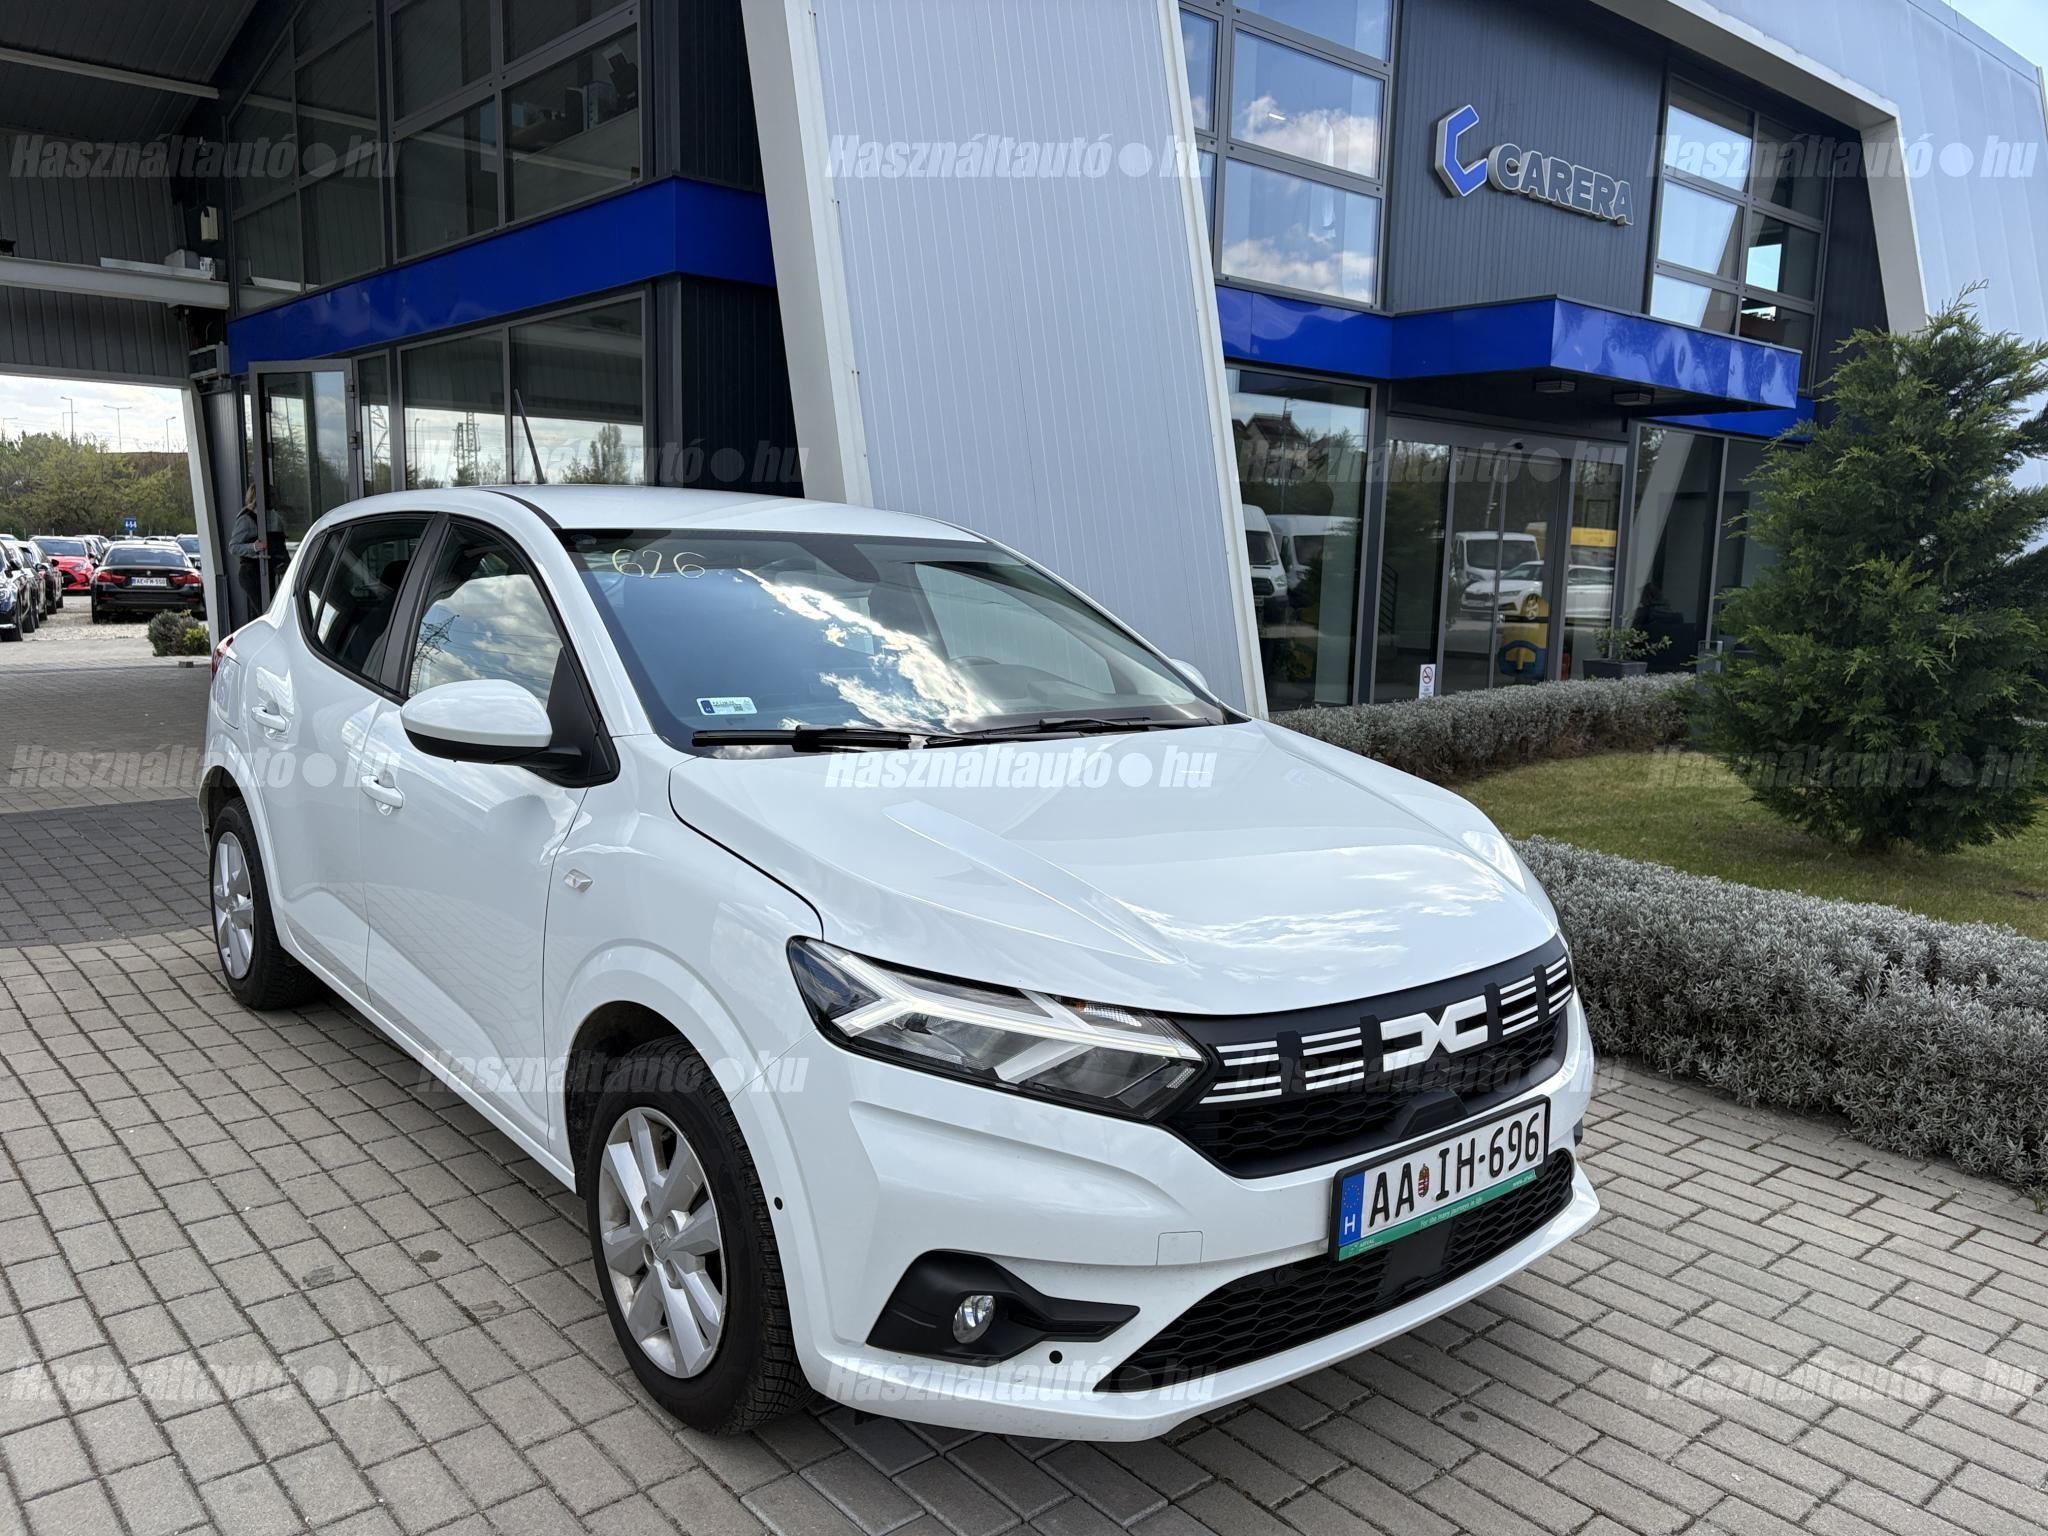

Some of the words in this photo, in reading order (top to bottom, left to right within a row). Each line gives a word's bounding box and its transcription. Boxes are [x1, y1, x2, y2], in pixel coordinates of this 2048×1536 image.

[1488, 143, 1634, 226] CARERA
[612, 548, 706, 579] 626
[1344, 1213, 1356, 1235] H
